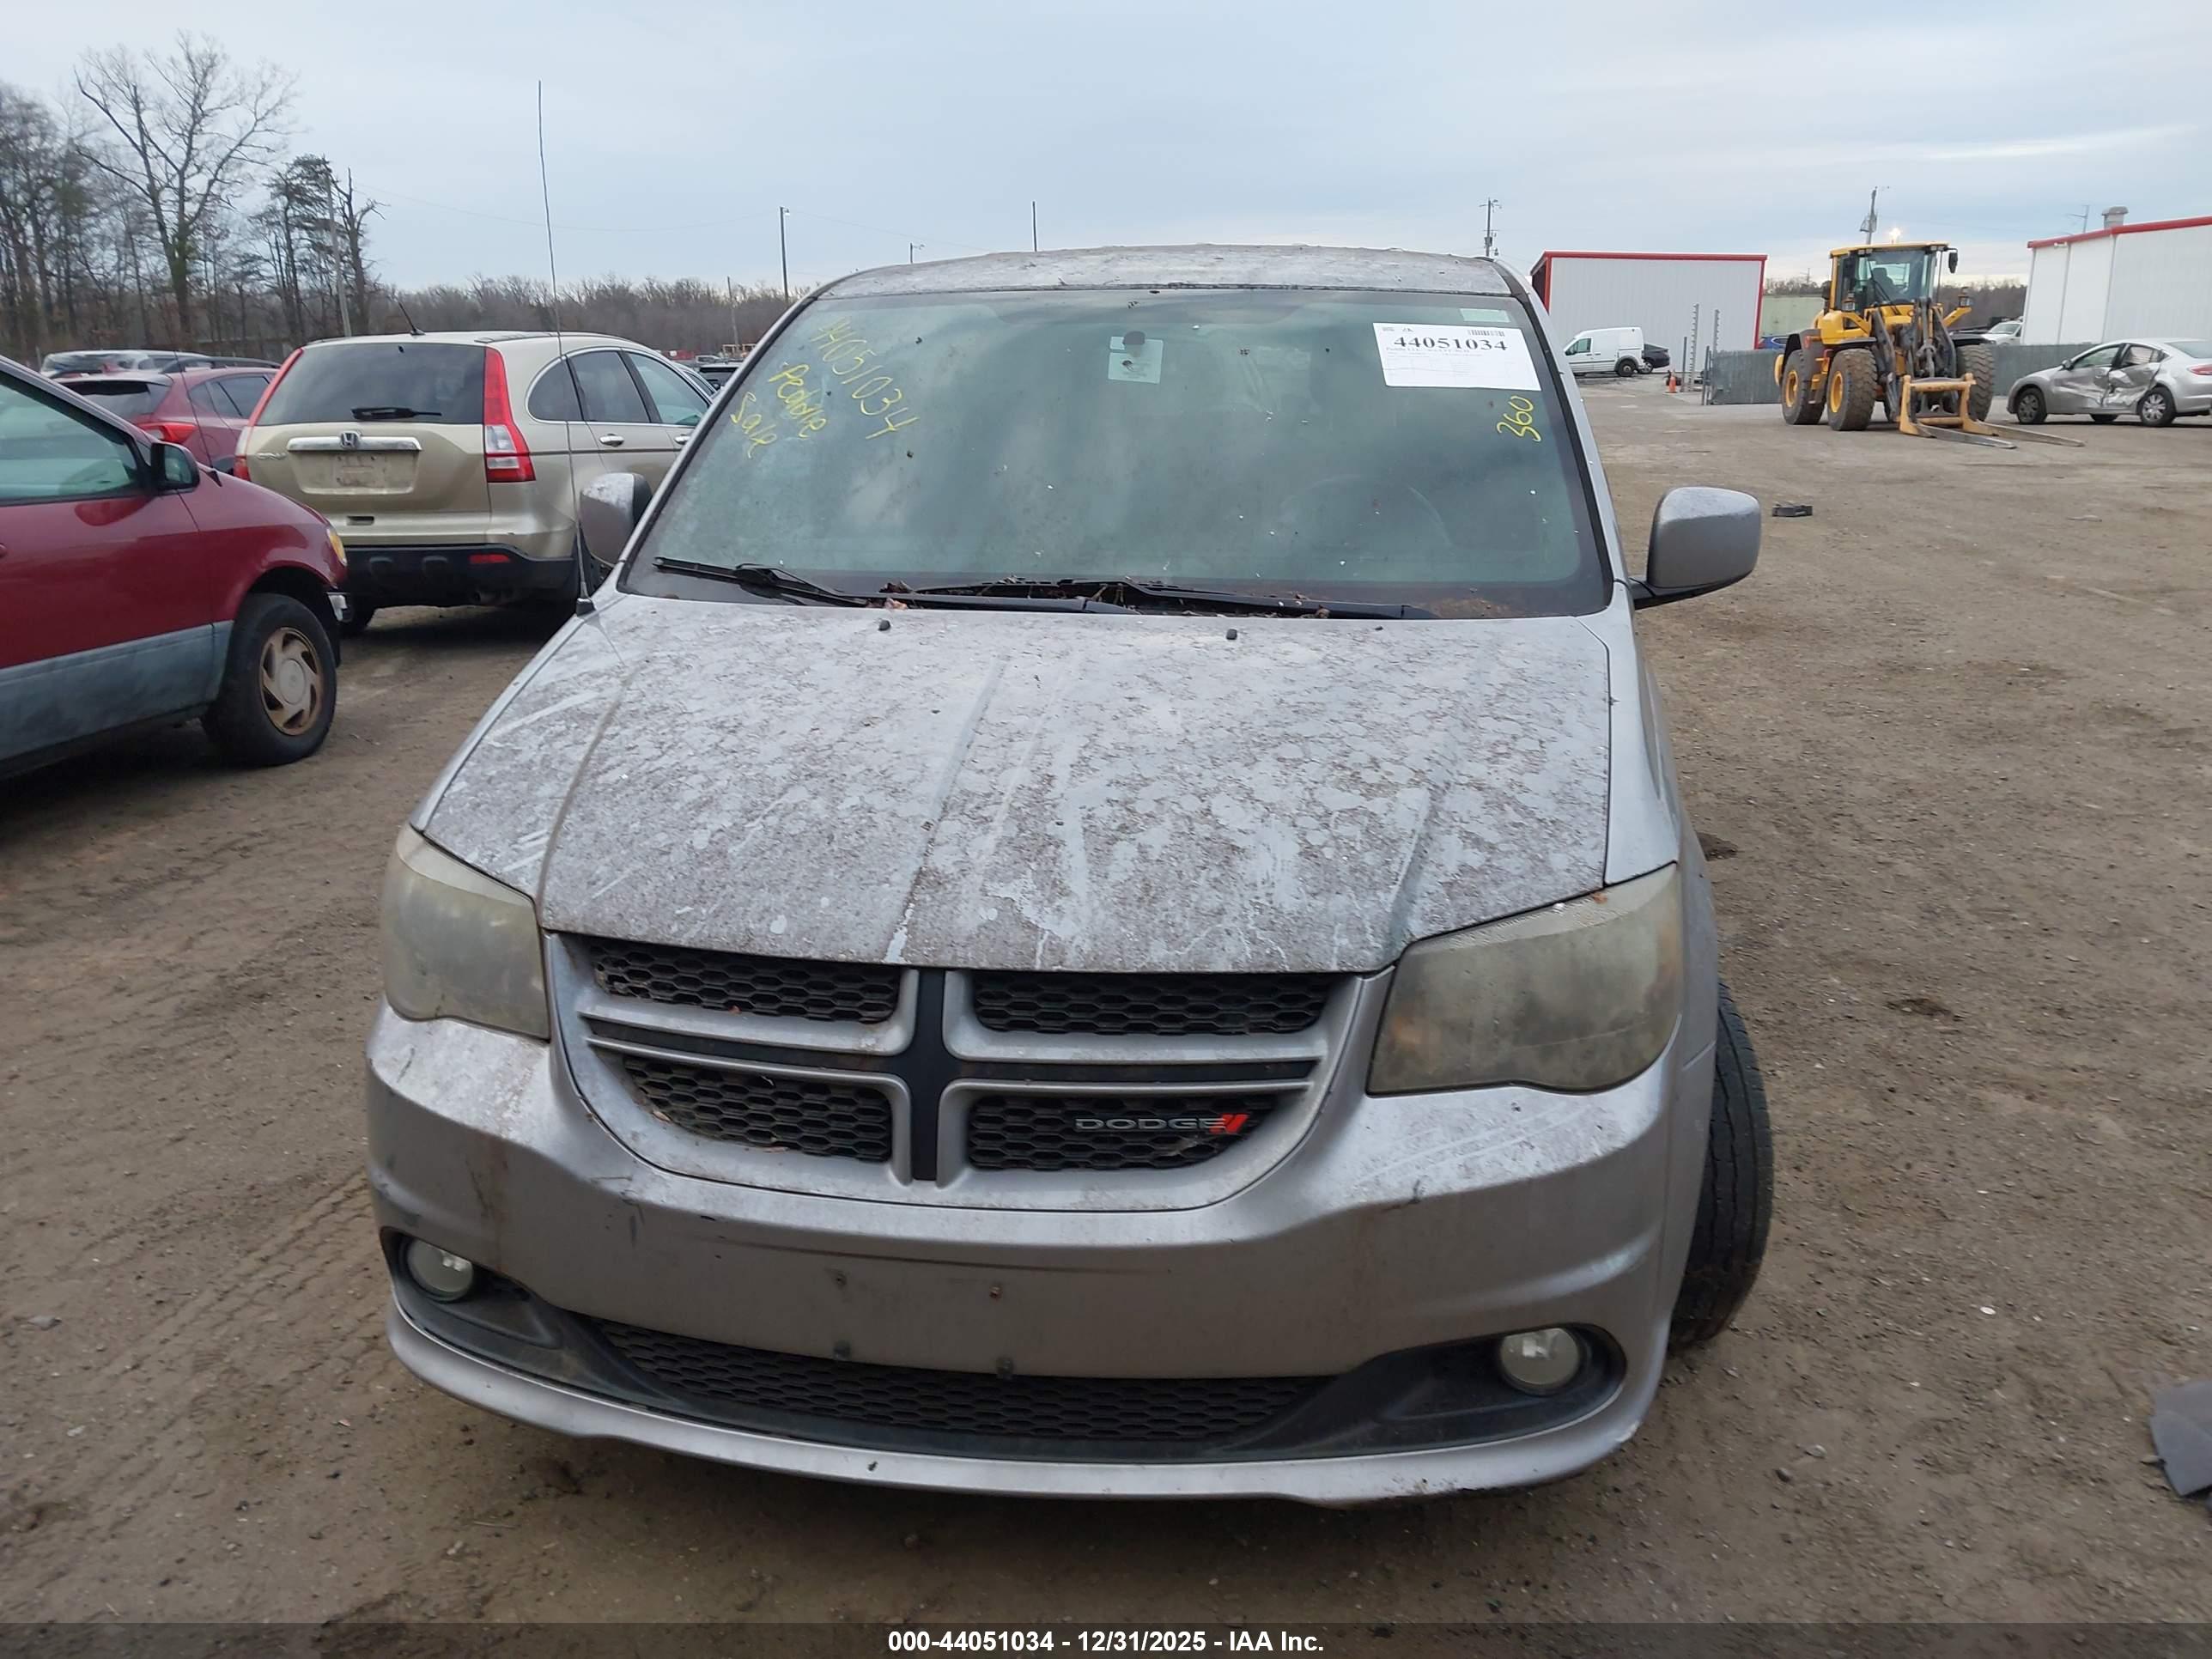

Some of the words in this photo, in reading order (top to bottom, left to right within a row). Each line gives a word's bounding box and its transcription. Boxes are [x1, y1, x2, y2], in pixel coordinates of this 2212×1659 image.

[1394, 336, 1509, 351] 44051034
[1496, 395, 1542, 442] 360
[1075, 1117, 1226, 1131] DODGE
